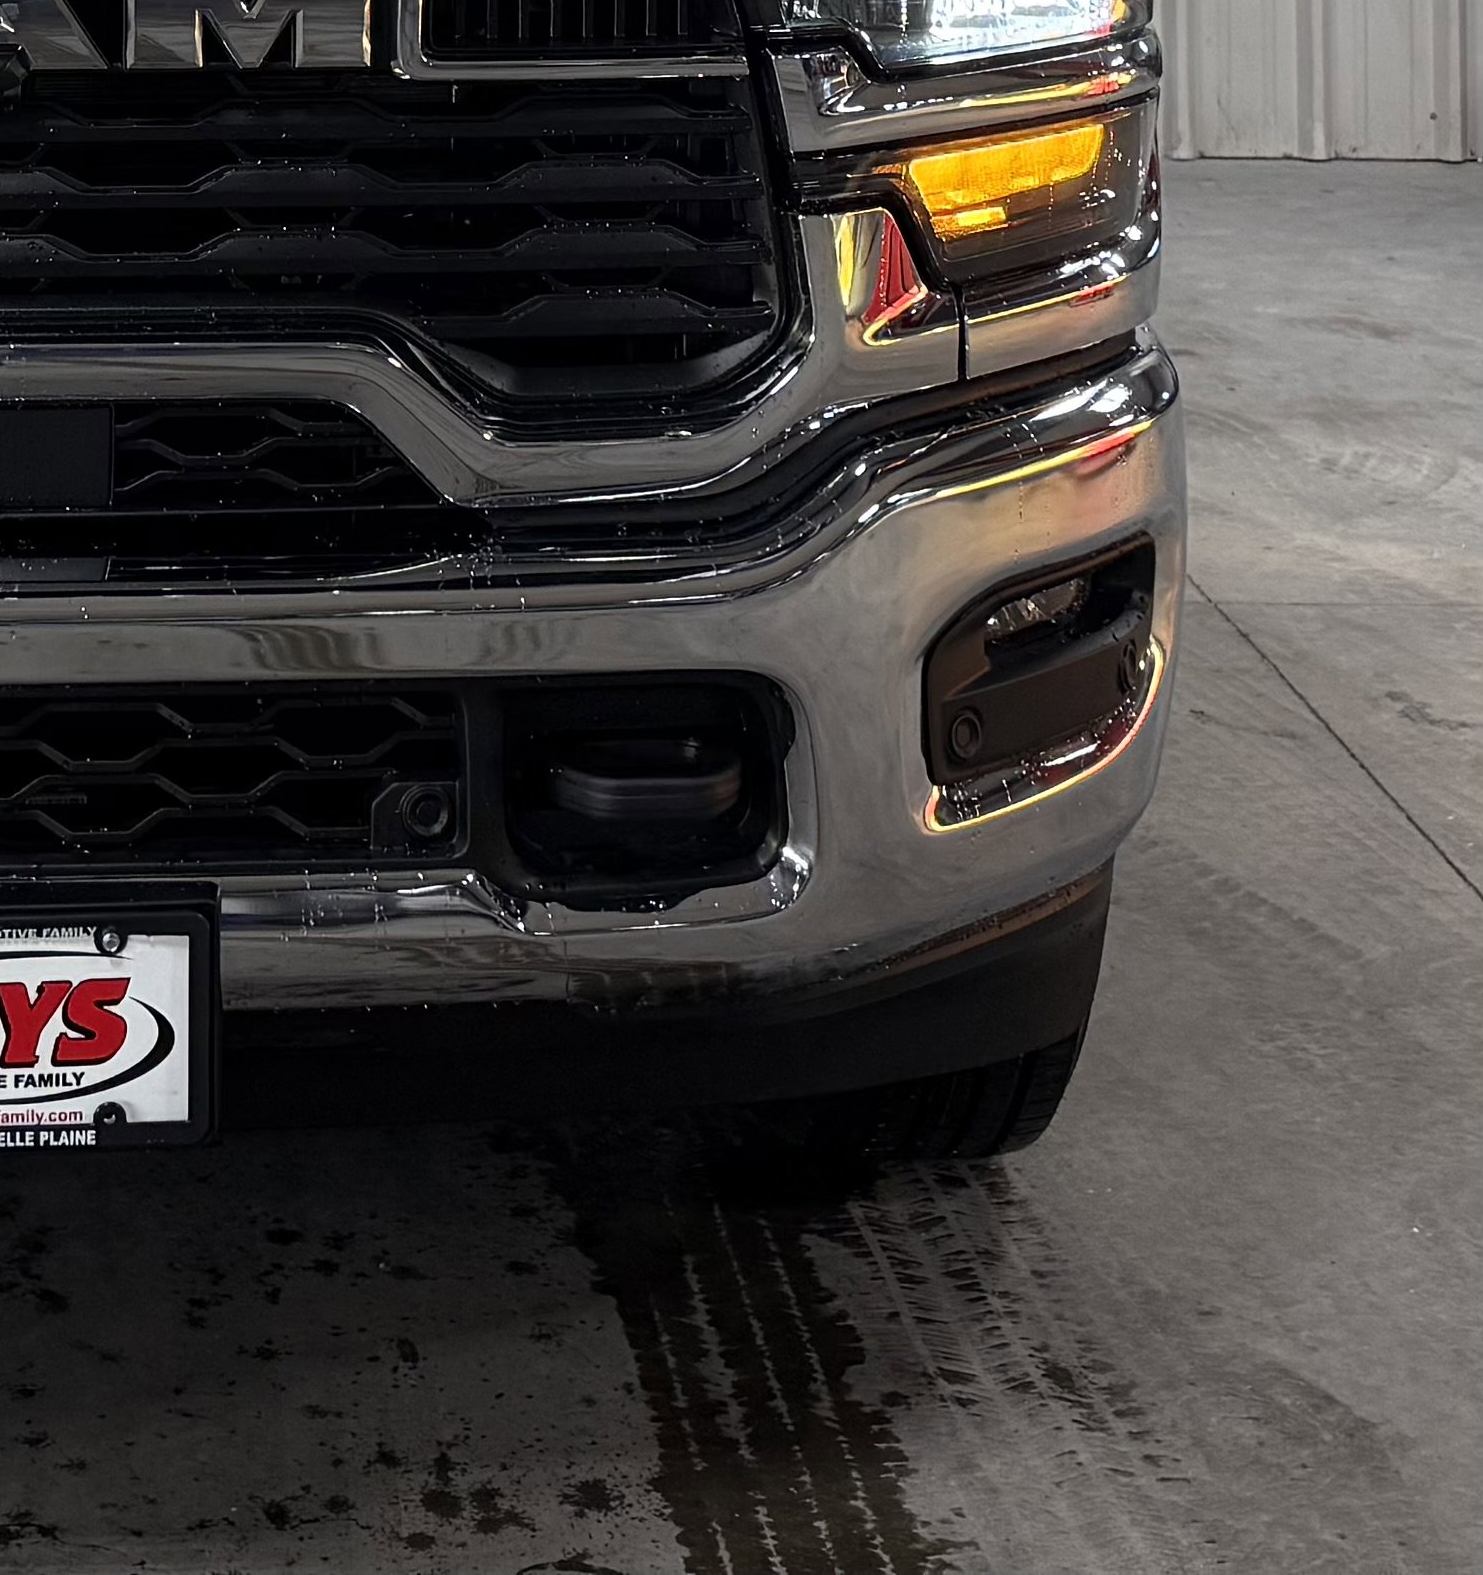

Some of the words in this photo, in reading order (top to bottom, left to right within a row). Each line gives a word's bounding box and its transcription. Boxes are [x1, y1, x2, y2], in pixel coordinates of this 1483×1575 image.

[42, 925, 98, 939] FAMILY
[13, 1072, 86, 1088] FAMILY
[39, 1130, 96, 1146] PLAINE
